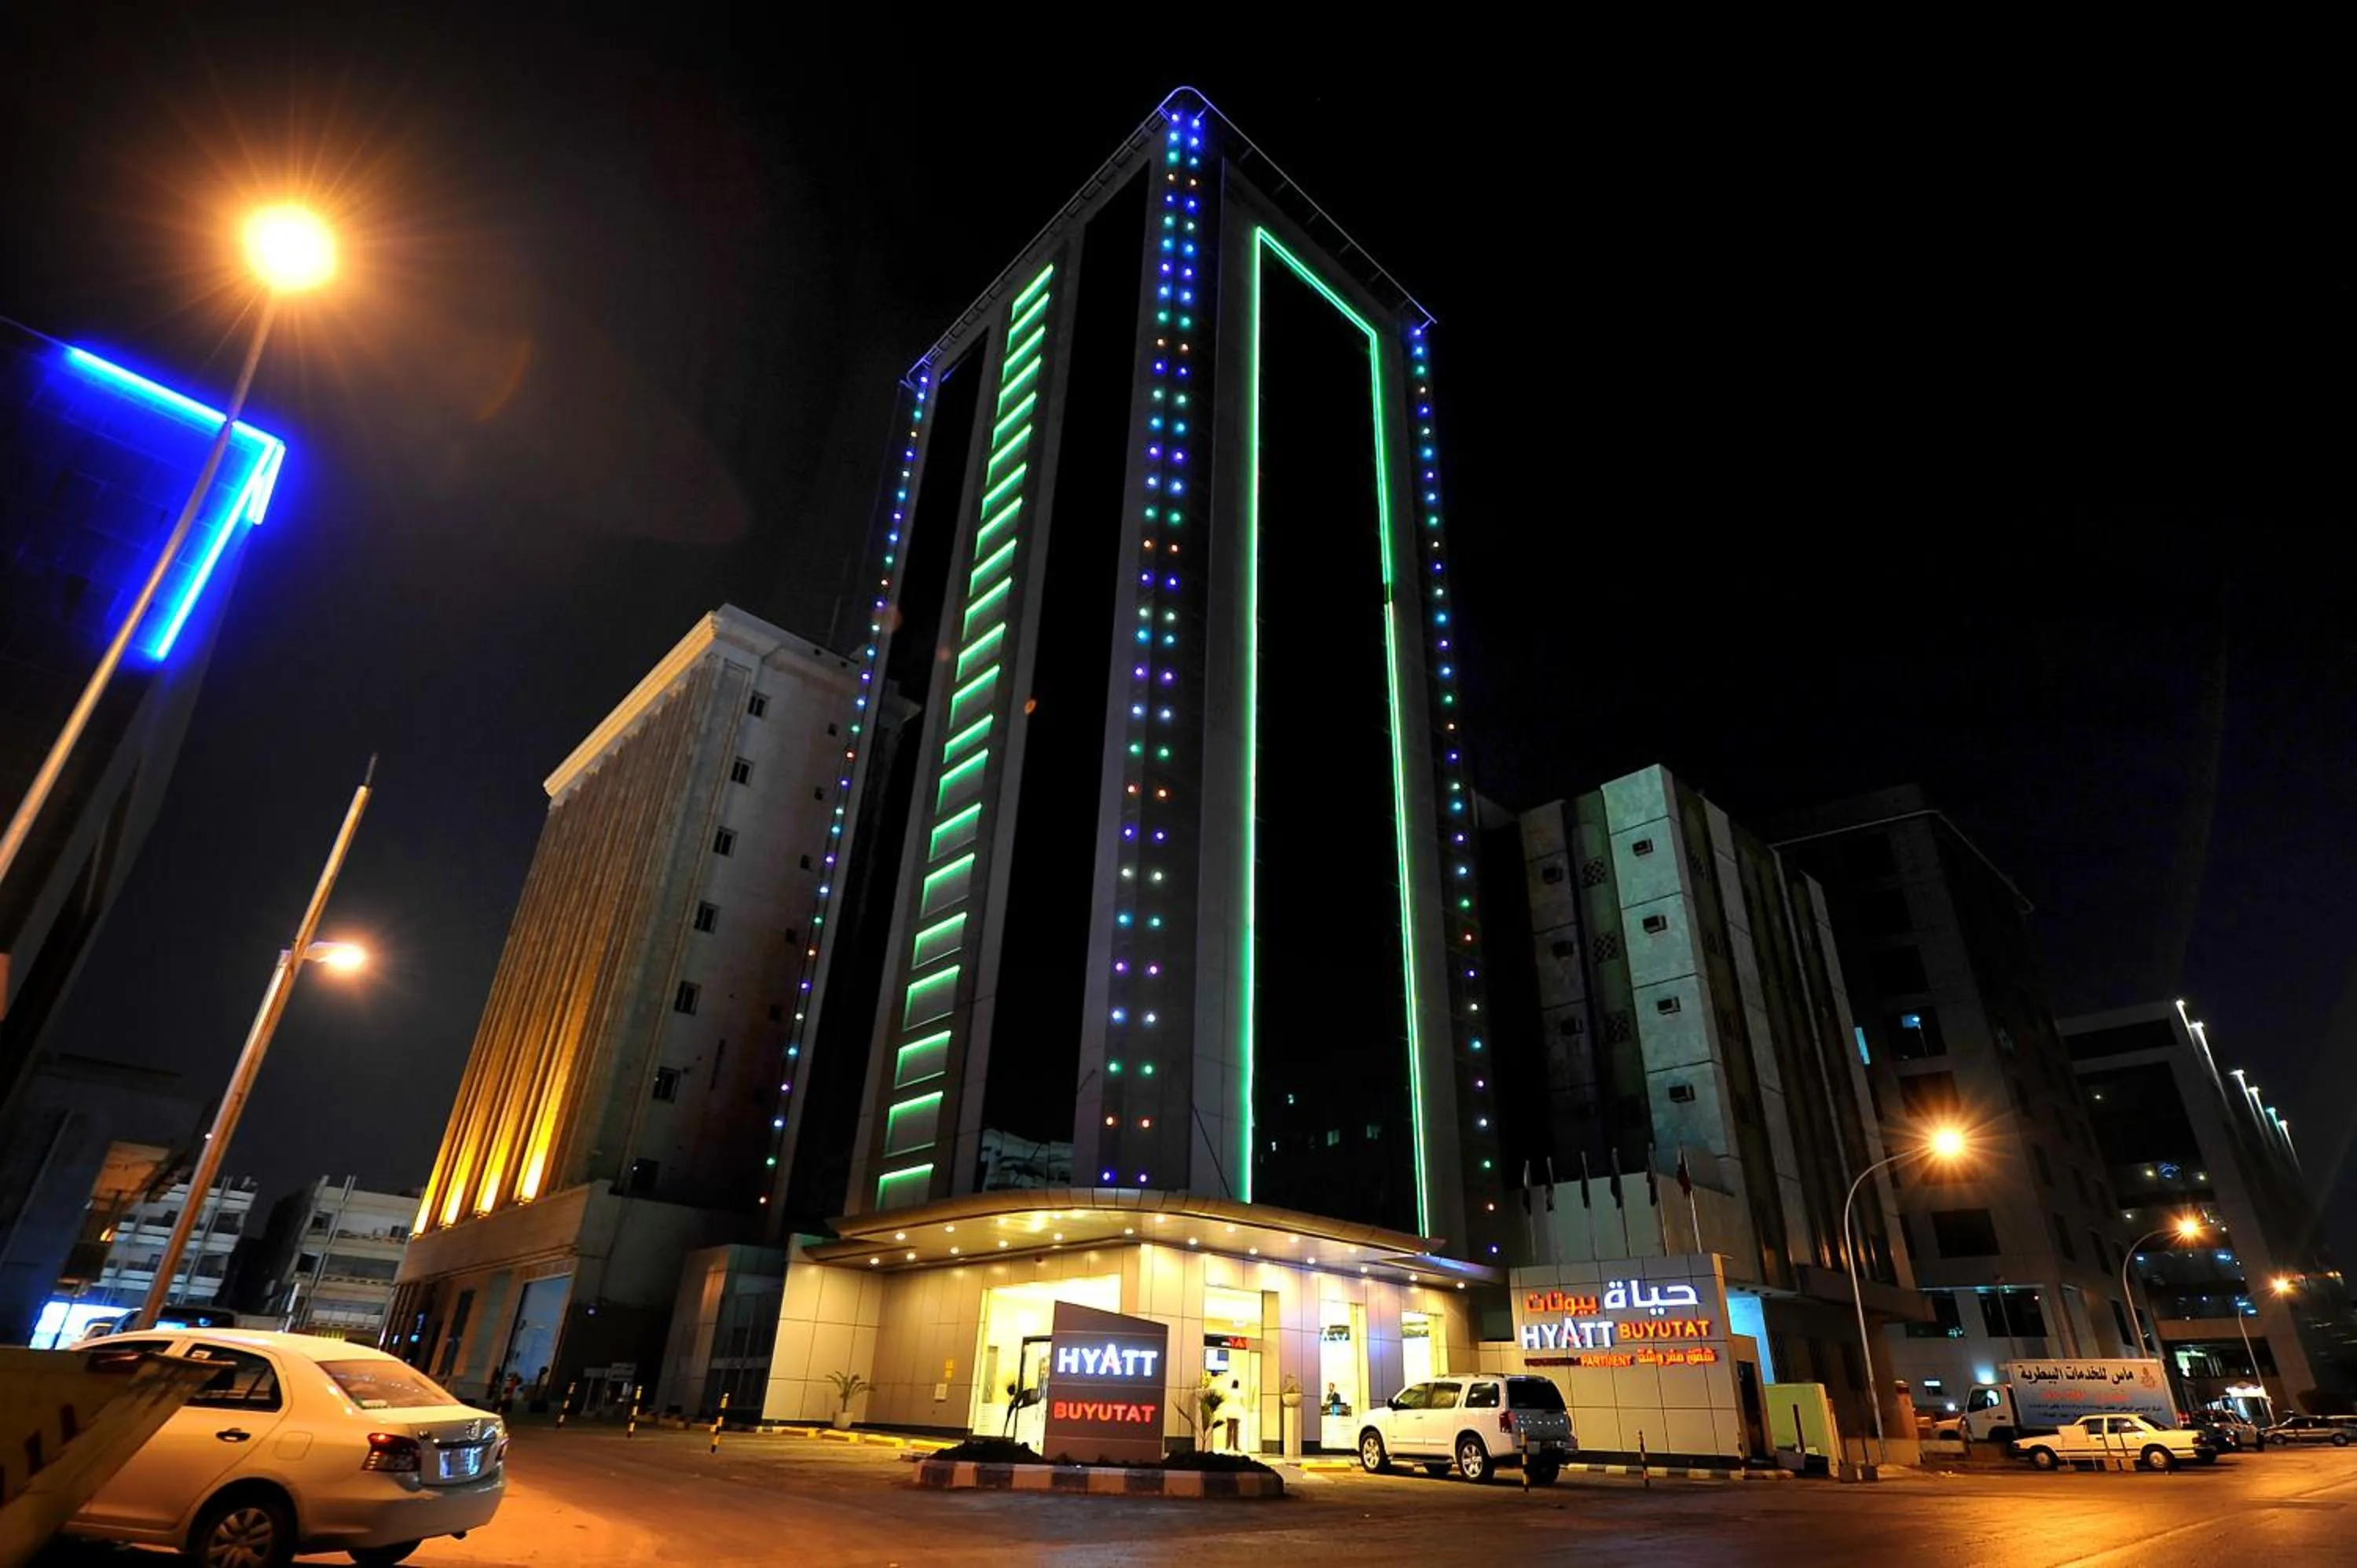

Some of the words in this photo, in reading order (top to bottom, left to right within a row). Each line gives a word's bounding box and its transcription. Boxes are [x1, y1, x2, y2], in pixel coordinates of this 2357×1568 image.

[1526, 1292, 1598, 1316] بيوتات
[1604, 1280, 1699, 1316] حياة
[1520, 1317, 1614, 1350] HYATT
[1618, 1320, 1710, 1339] BUYUTAT
[1057, 1343, 1158, 1376] HYATT
[1054, 1401, 1157, 1423] BUYUTAT
